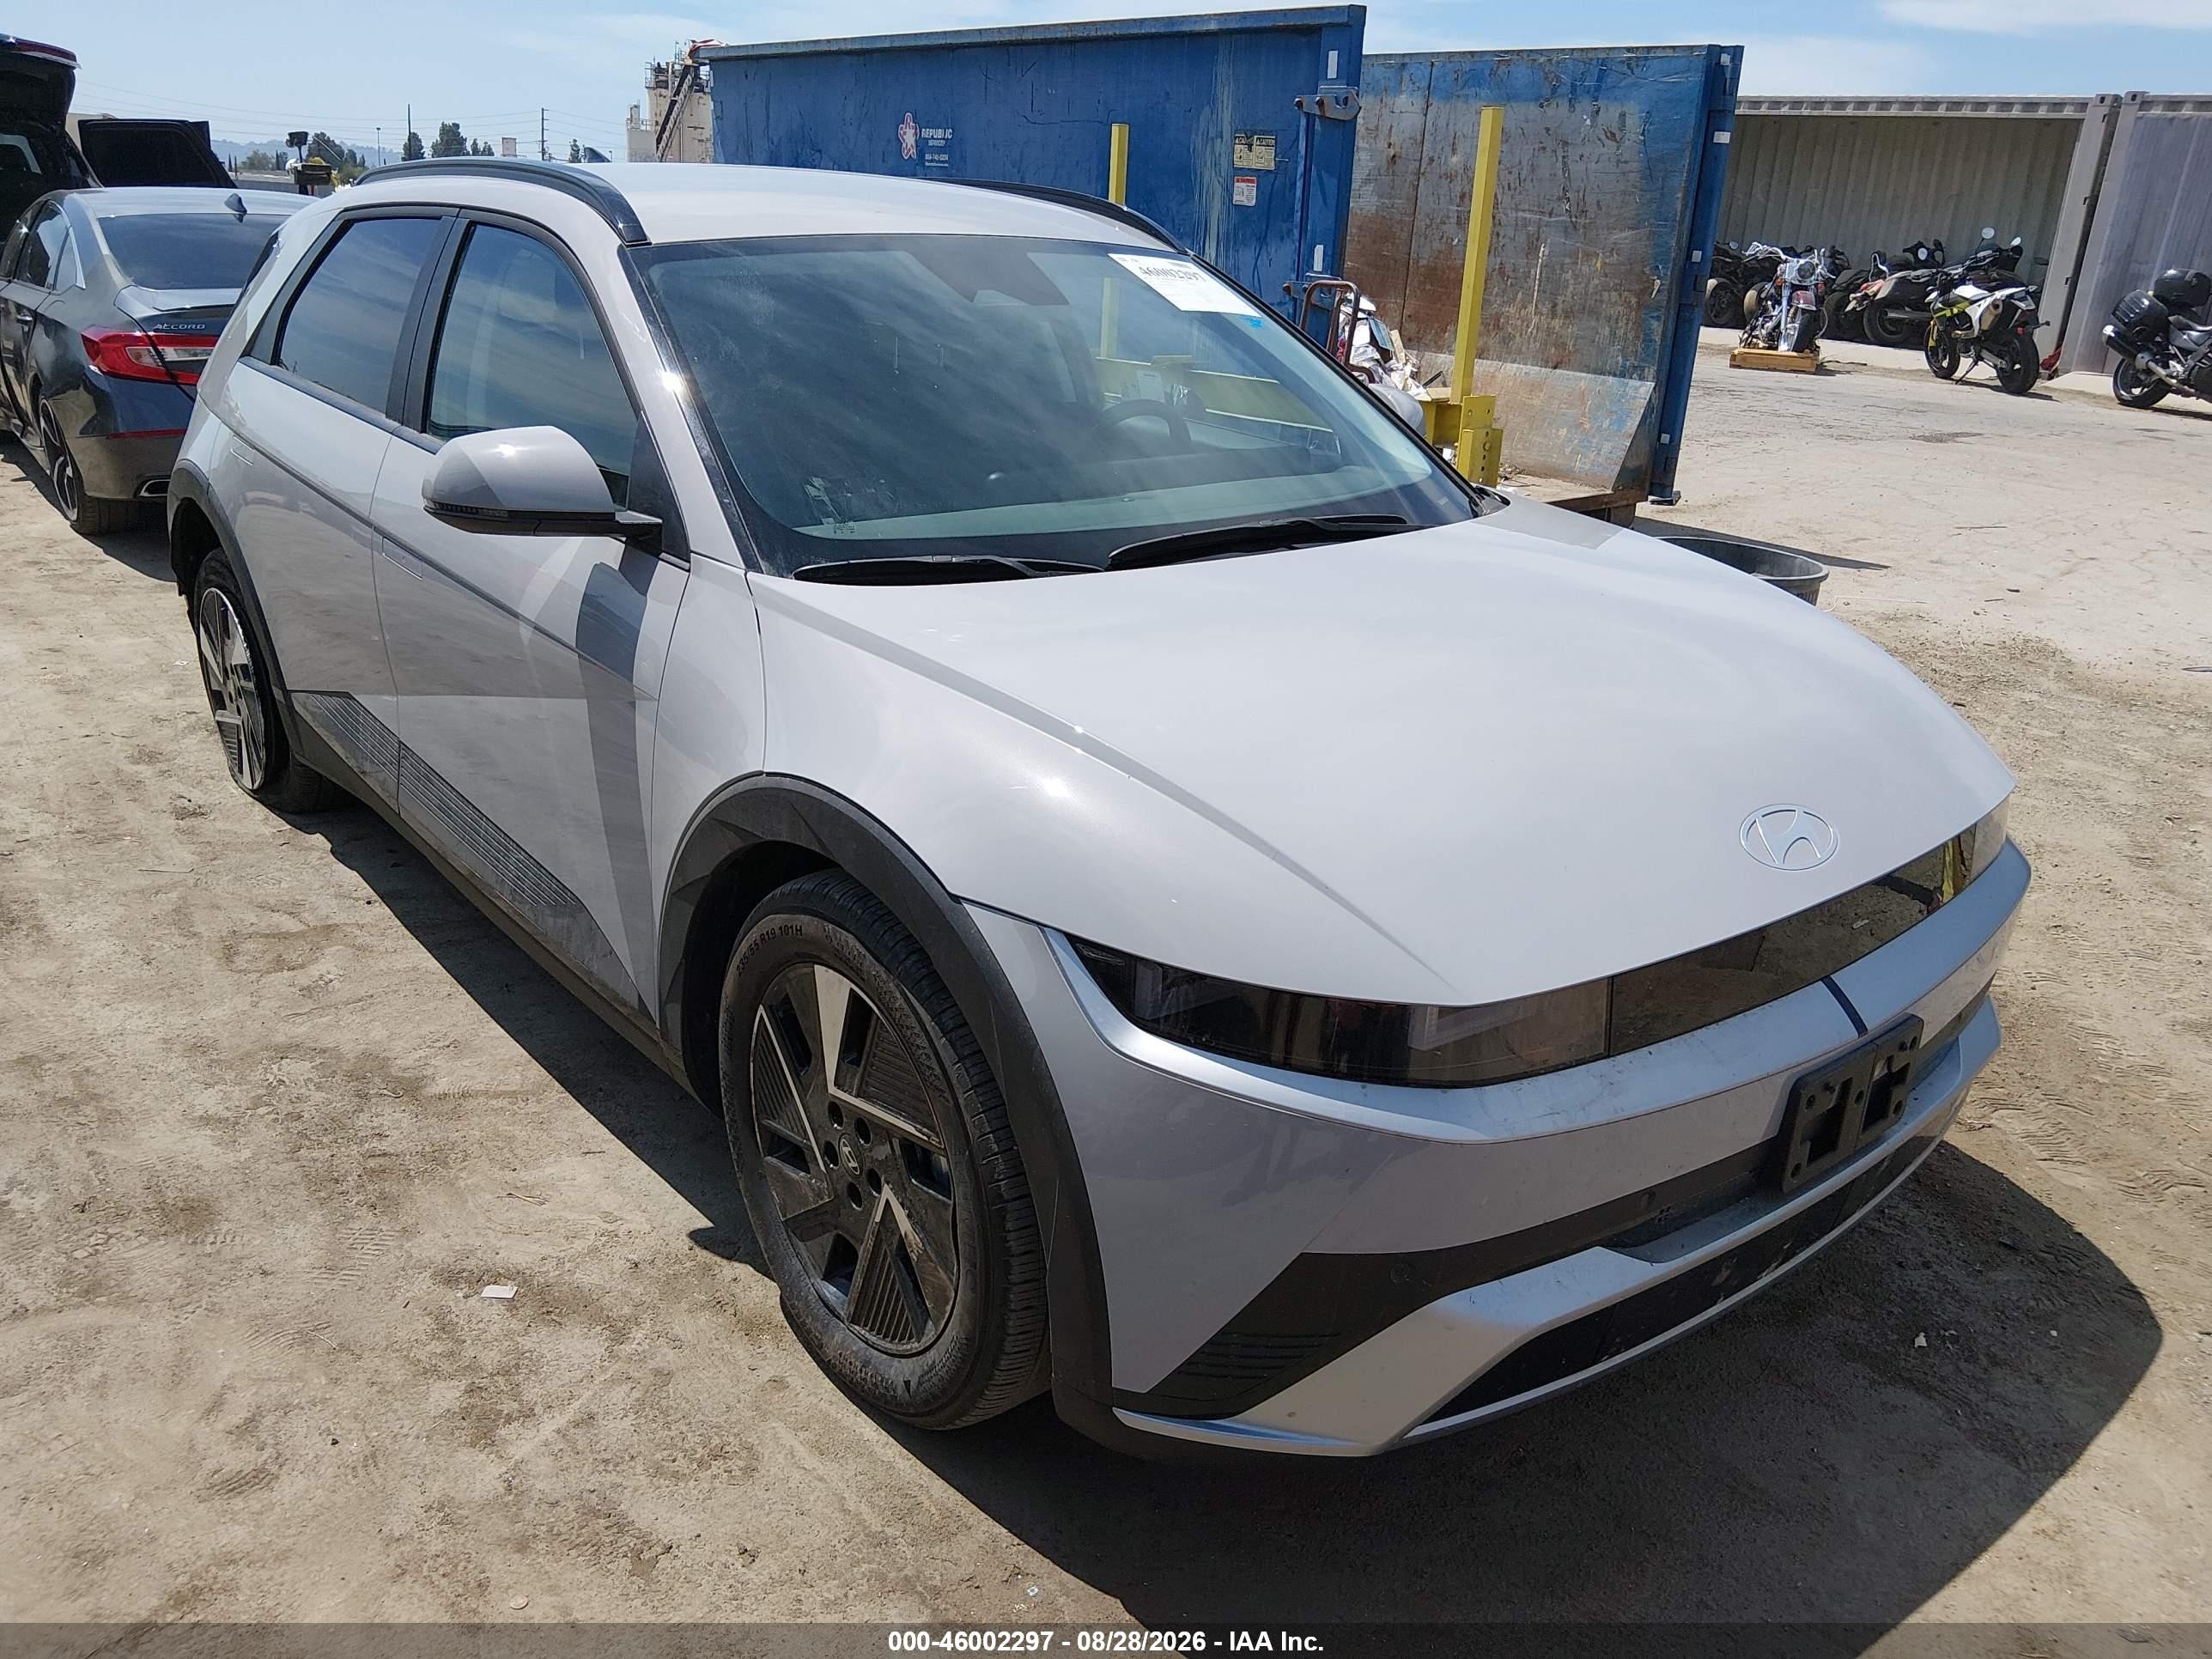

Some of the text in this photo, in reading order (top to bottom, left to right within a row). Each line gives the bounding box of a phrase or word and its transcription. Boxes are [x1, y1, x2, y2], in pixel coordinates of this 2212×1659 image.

[921, 128, 953, 138] REPUBLIC
[760, 927, 776, 945] R19
[779, 924, 803, 936] 101H
